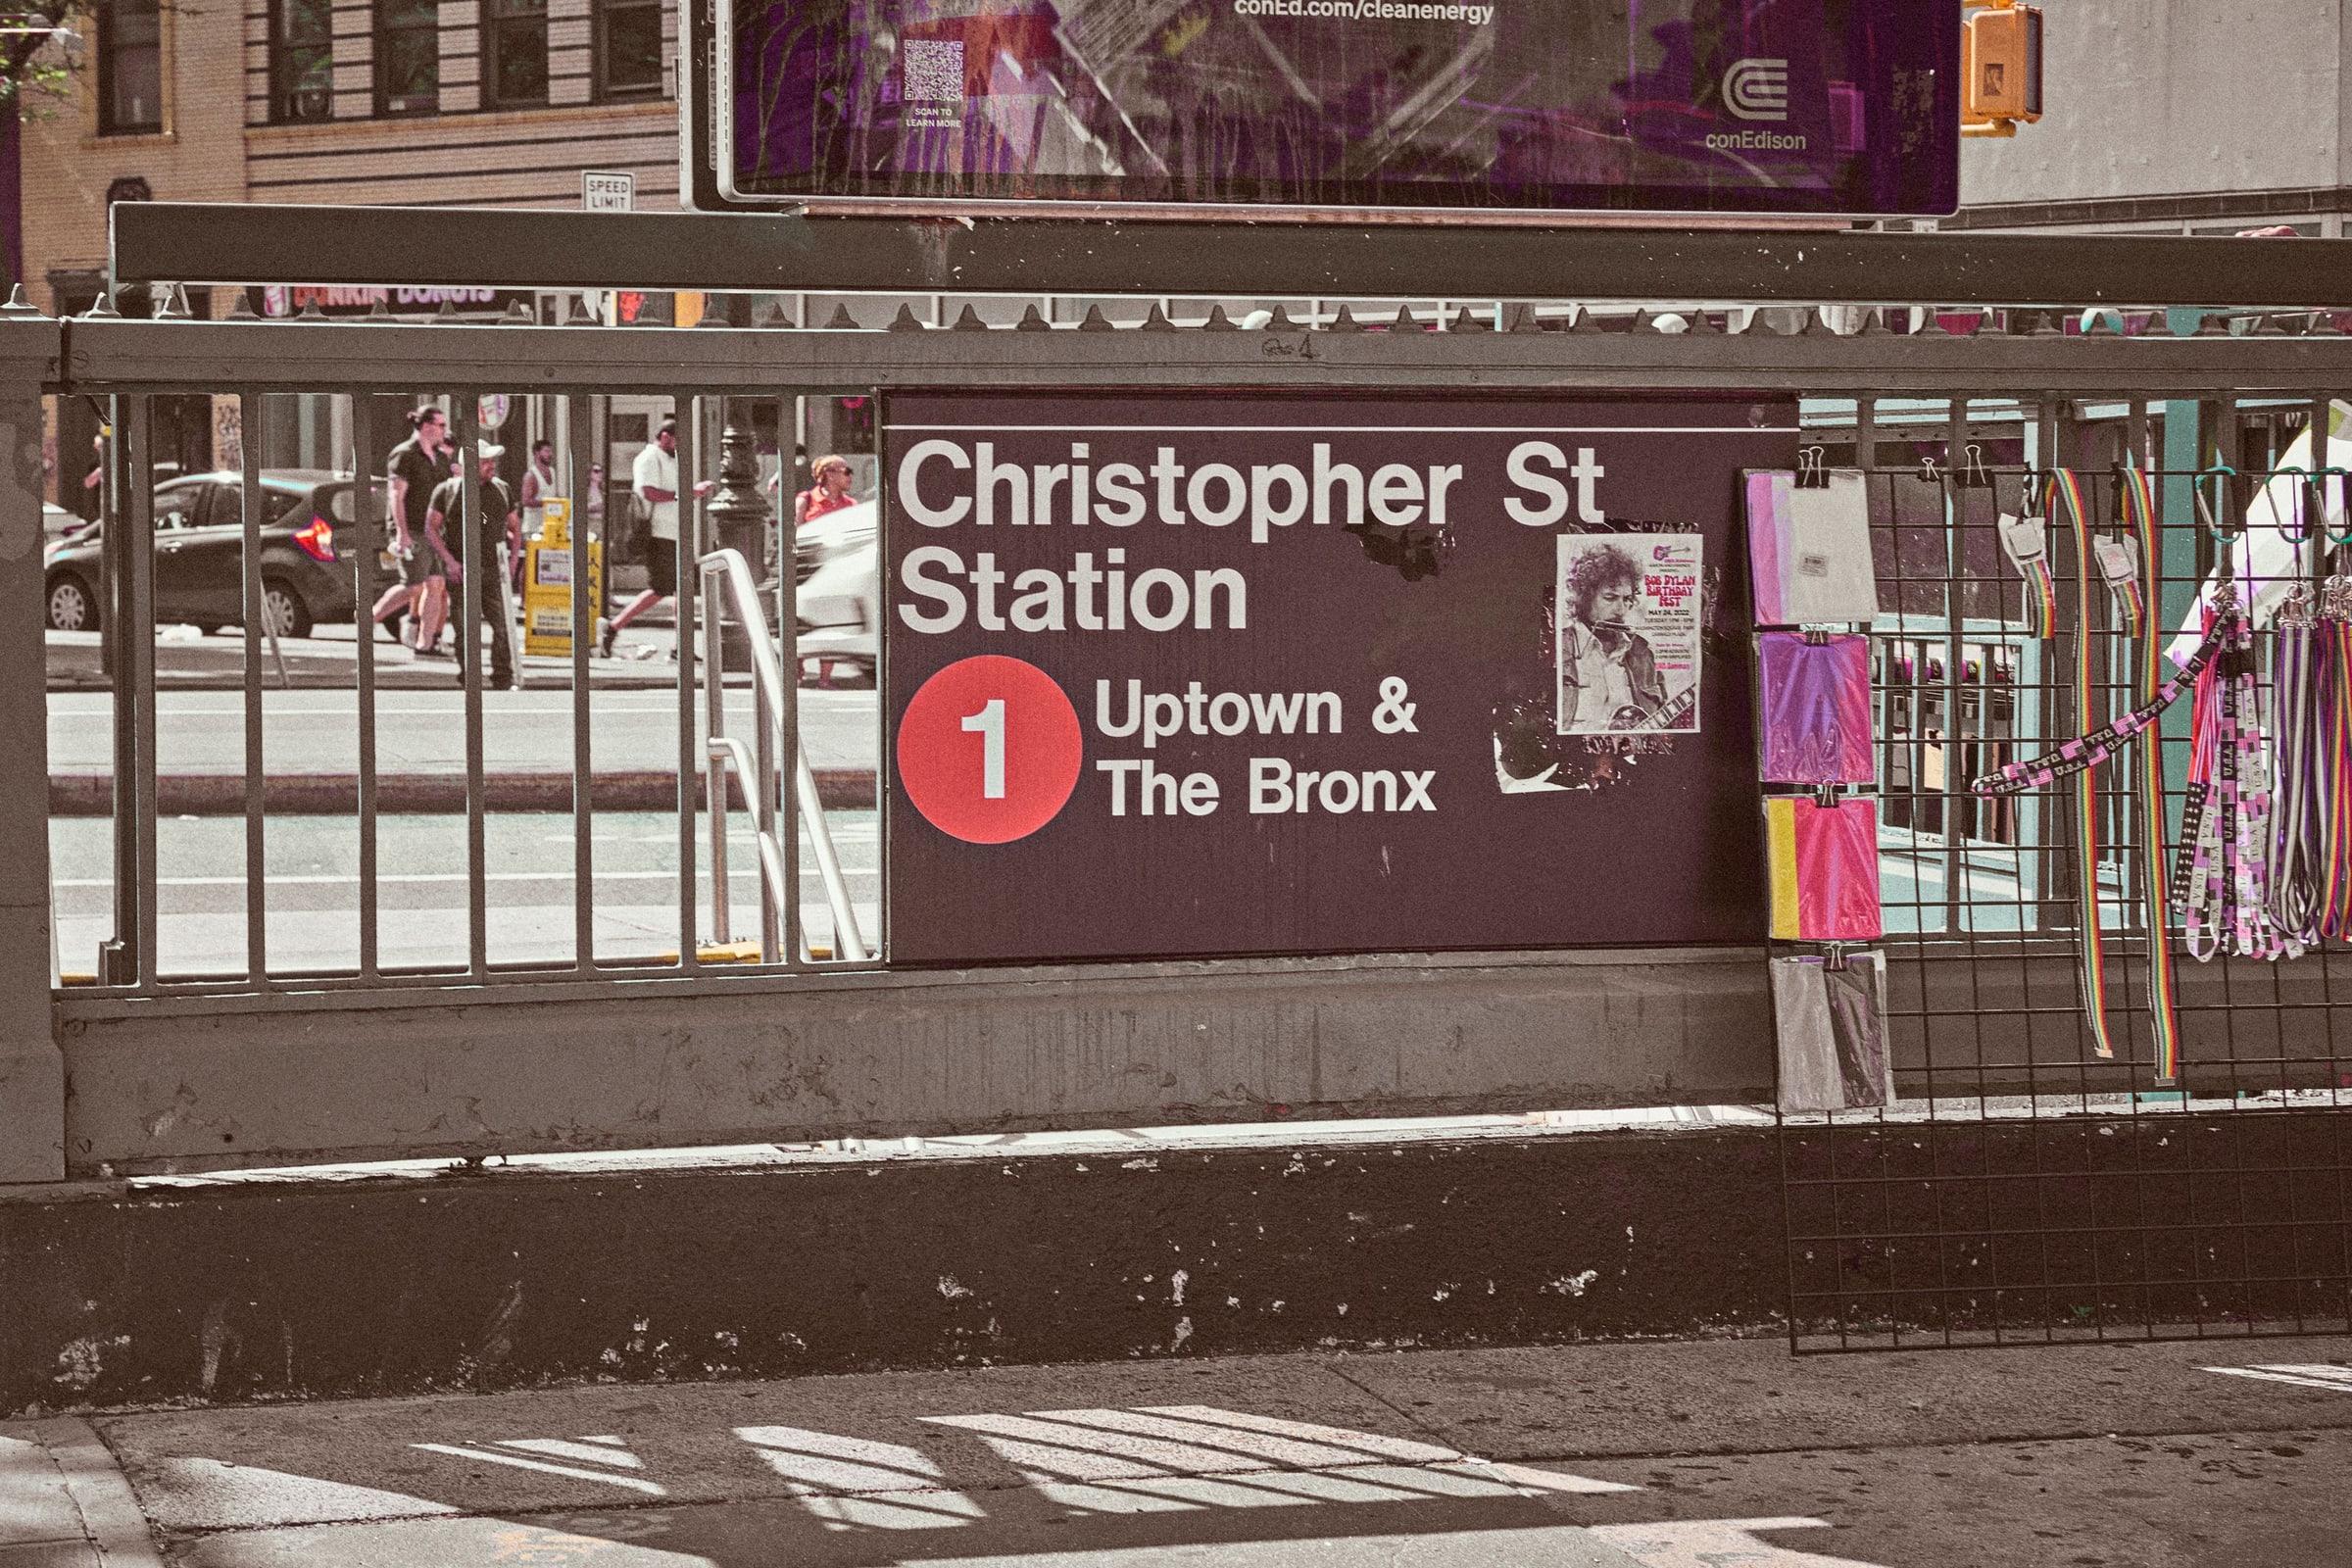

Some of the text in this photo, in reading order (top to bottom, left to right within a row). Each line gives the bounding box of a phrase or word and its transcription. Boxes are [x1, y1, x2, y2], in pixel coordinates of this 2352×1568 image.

[1235, 0, 1494, 24] conEd.com/cleanenergy
[1705, 130, 1807, 150] conEdison
[589, 180, 628, 192] SPEED
[592, 197, 626, 208] LIMIT
[898, 439, 1605, 544] Christopher St
[898, 545, 1248, 634] Station
[1644, 575, 1695, 586] BOB DYLAN
[1096, 675, 1419, 749] Uptown &
[961, 699, 1005, 799] 1
[1096, 757, 1438, 816] The Bronx
